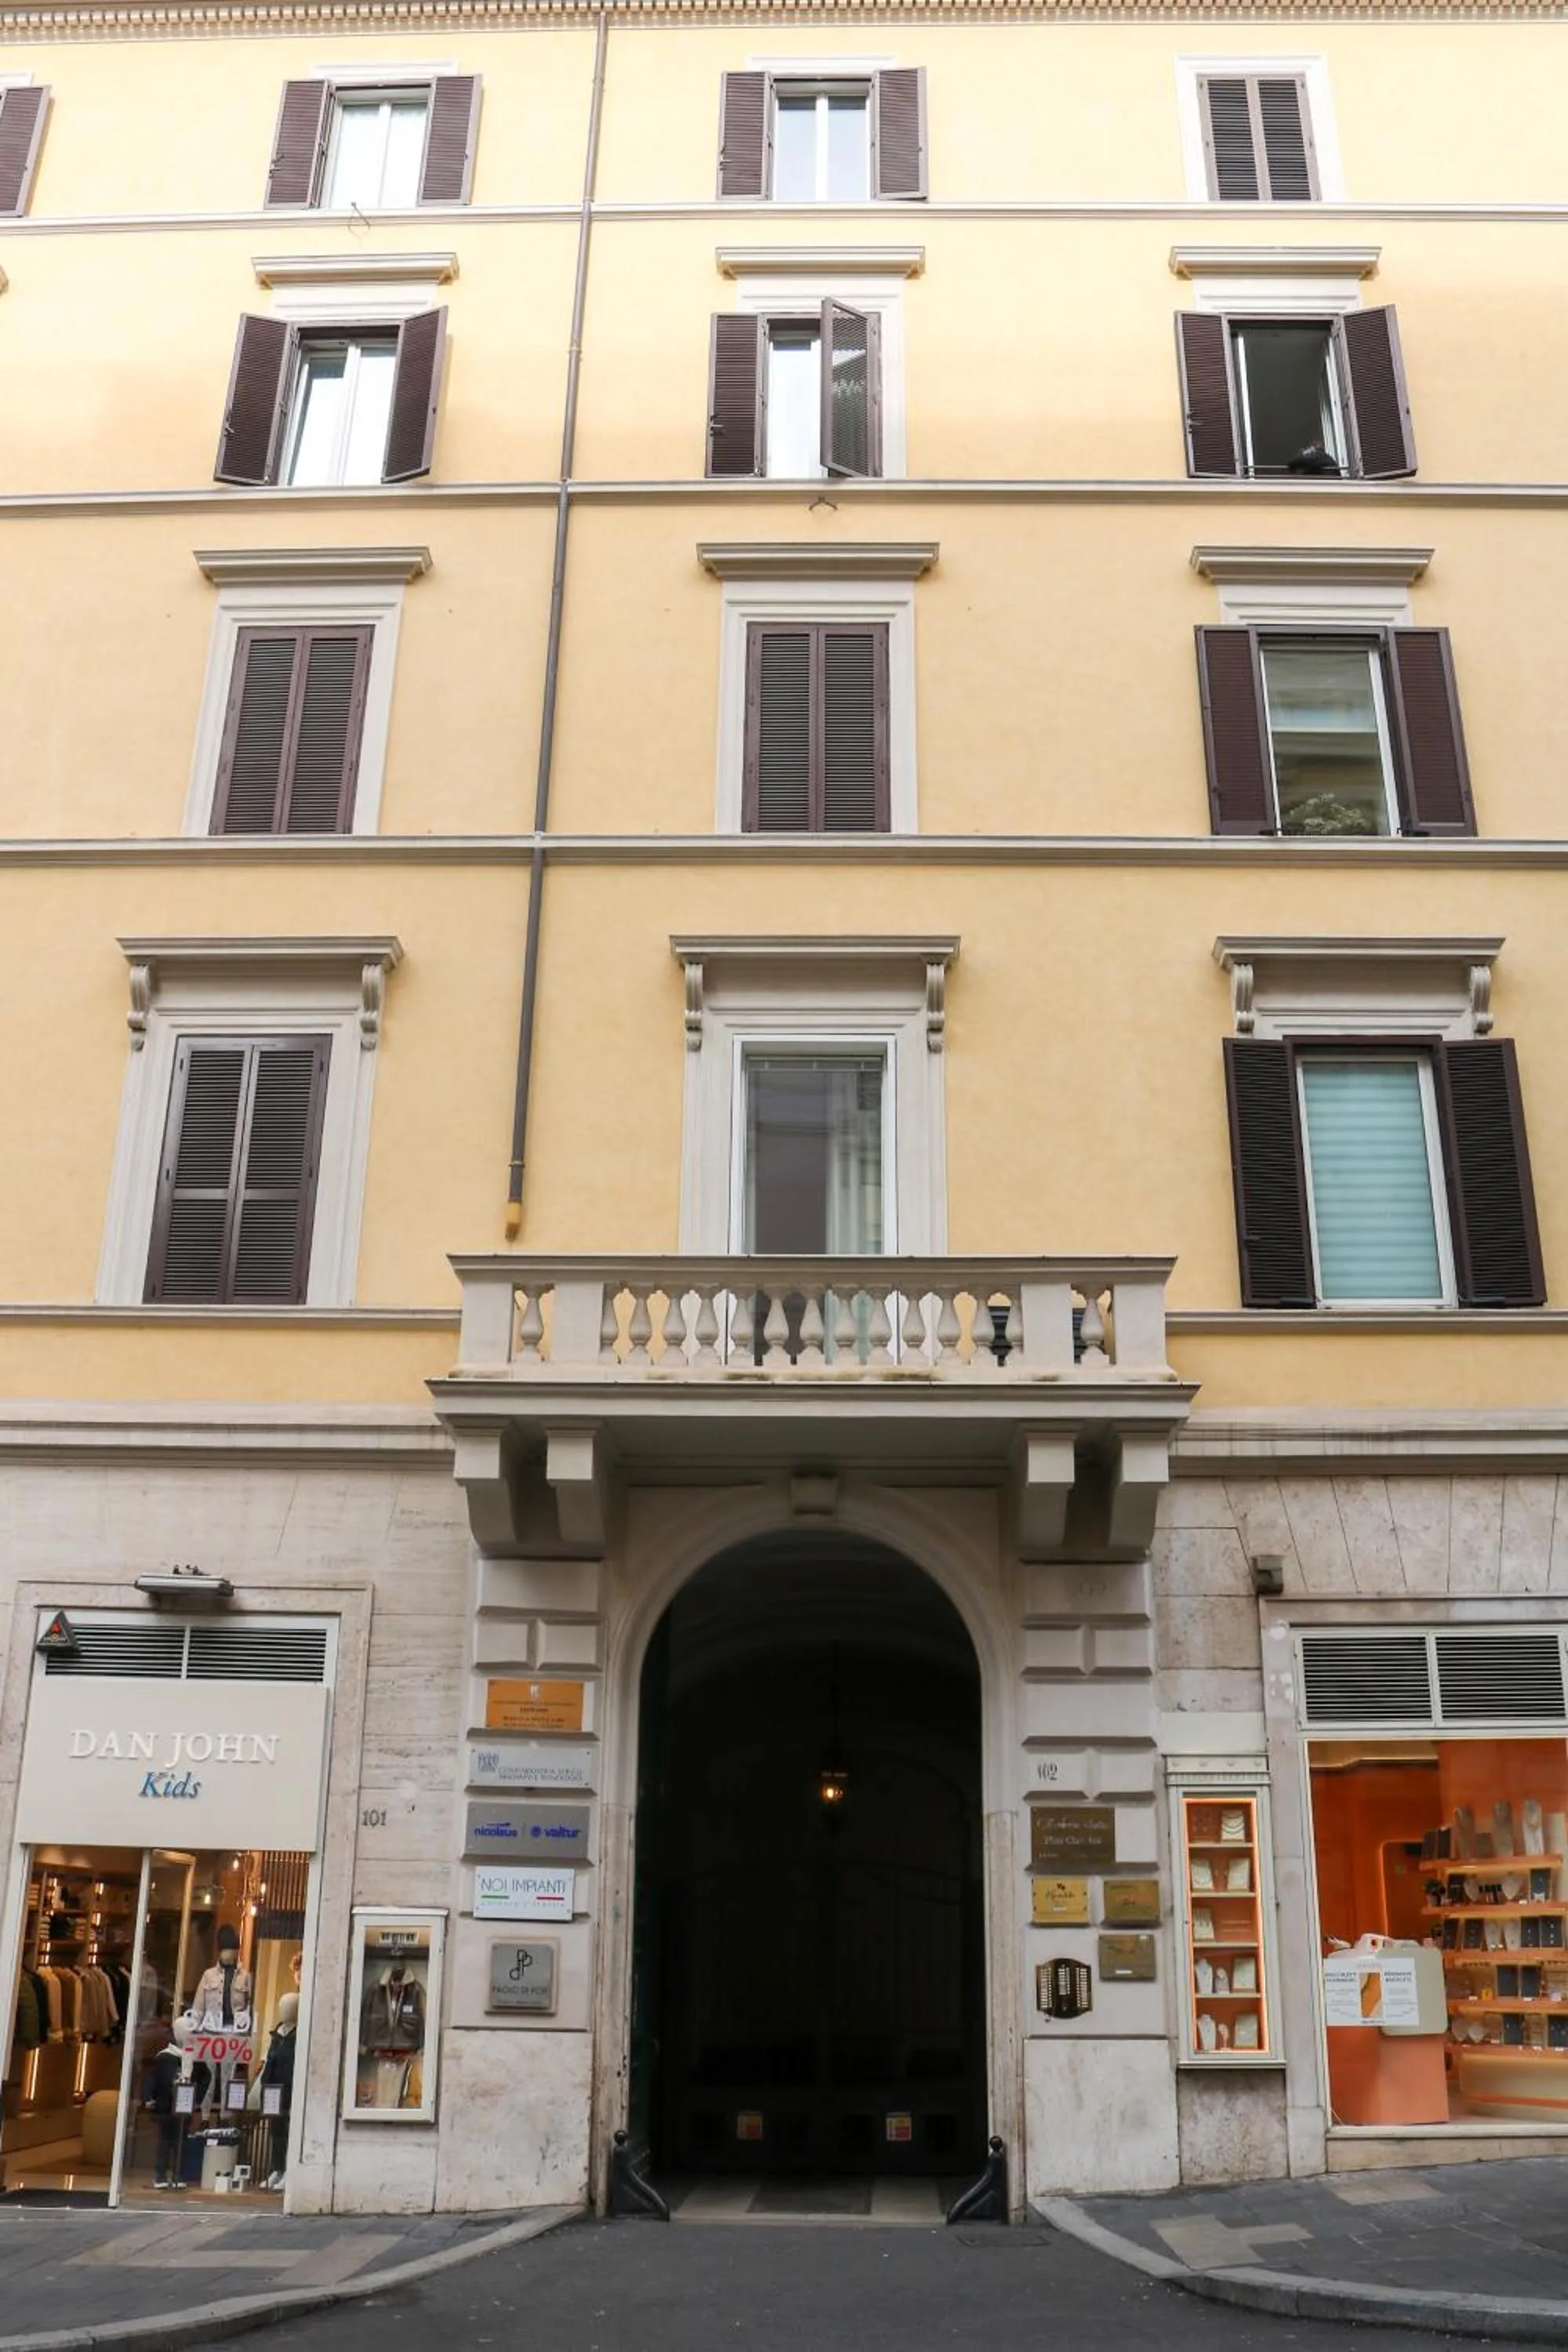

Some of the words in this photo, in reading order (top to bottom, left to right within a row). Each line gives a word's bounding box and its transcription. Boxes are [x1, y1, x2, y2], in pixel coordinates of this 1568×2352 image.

[70, 1730, 158, 1759] DAN
[165, 1731, 280, 1768] JOHN
[1038, 1763, 1058, 1780] 102
[139, 1771, 201, 1798] Kids
[361, 1809, 387, 1828] 101
[481, 1878, 507, 1891] NOI
[512, 1878, 565, 1893] IMPIANTI
[184, 2038, 252, 2062] -70%
